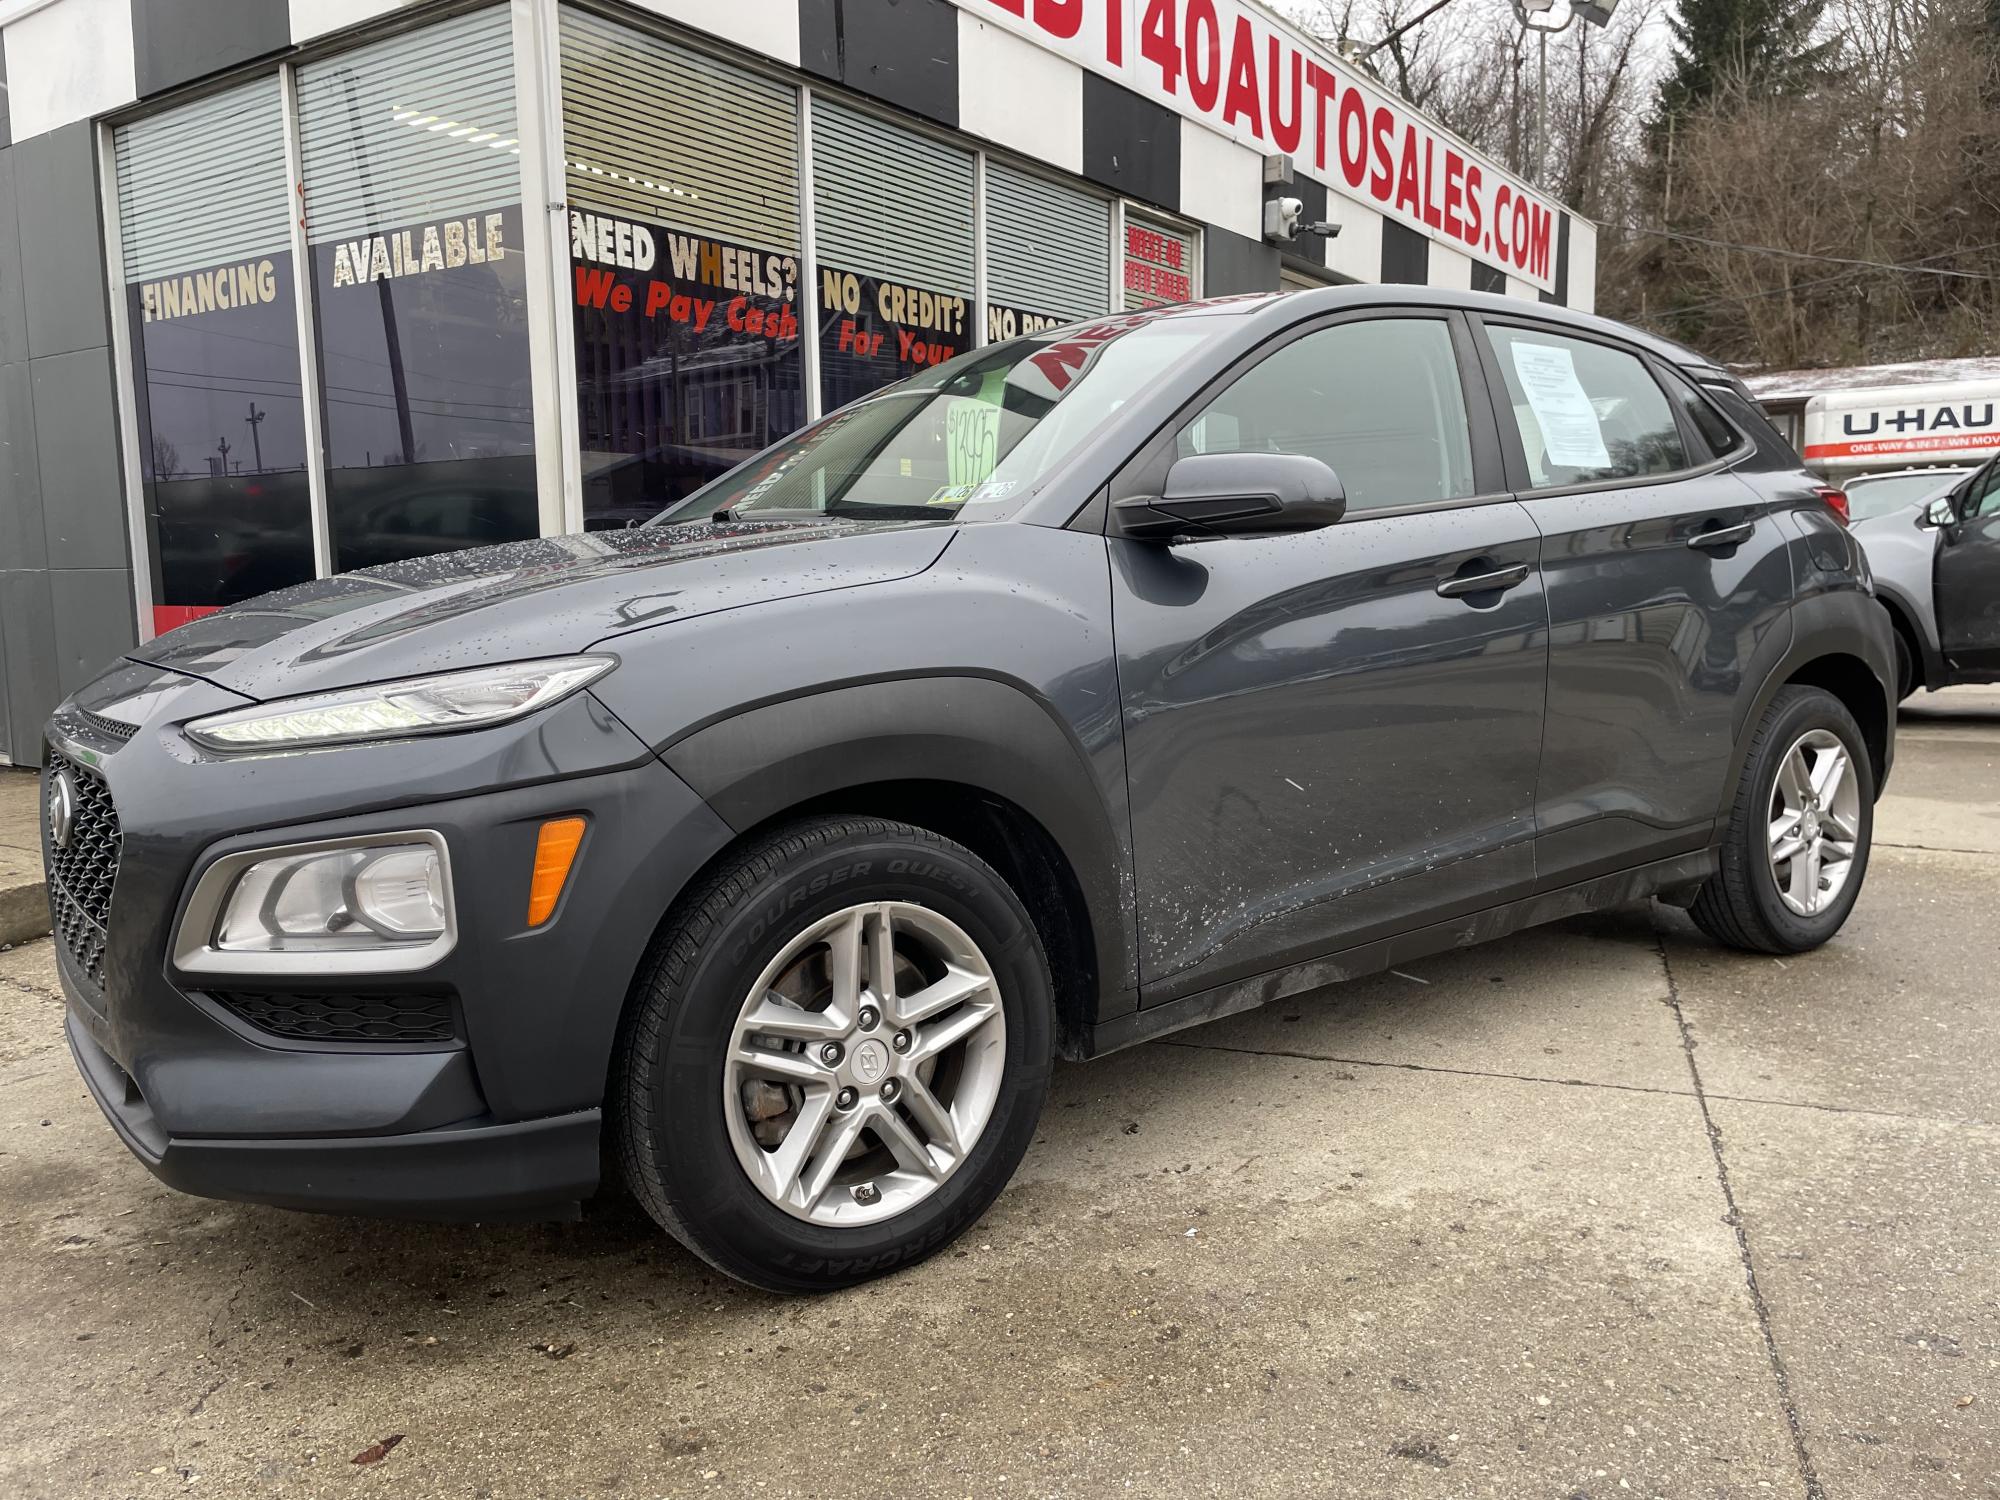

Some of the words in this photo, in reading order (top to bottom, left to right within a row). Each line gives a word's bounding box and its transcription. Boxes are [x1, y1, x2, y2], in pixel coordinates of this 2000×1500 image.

[142, 259, 276, 323] FINANCING
[333, 213, 504, 289] AVAILABLE
[570, 210, 656, 272] NEED
[667, 233, 797, 302] WHEELS?
[1127, 225, 1164, 264] WEST
[575, 266, 633, 313] We
[645, 280, 714, 334] Pay
[727, 296, 798, 341] Cash
[823, 269, 861, 315] NO
[878, 282, 965, 336] CREDIT?
[1154, 268, 1189, 303] SALES
[838, 319, 884, 358] For
[898, 329, 955, 368] Your
[988, 306, 1017, 342] NO
[732, 861, 873, 967] COURSER
[887, 859, 981, 899] QUEST
